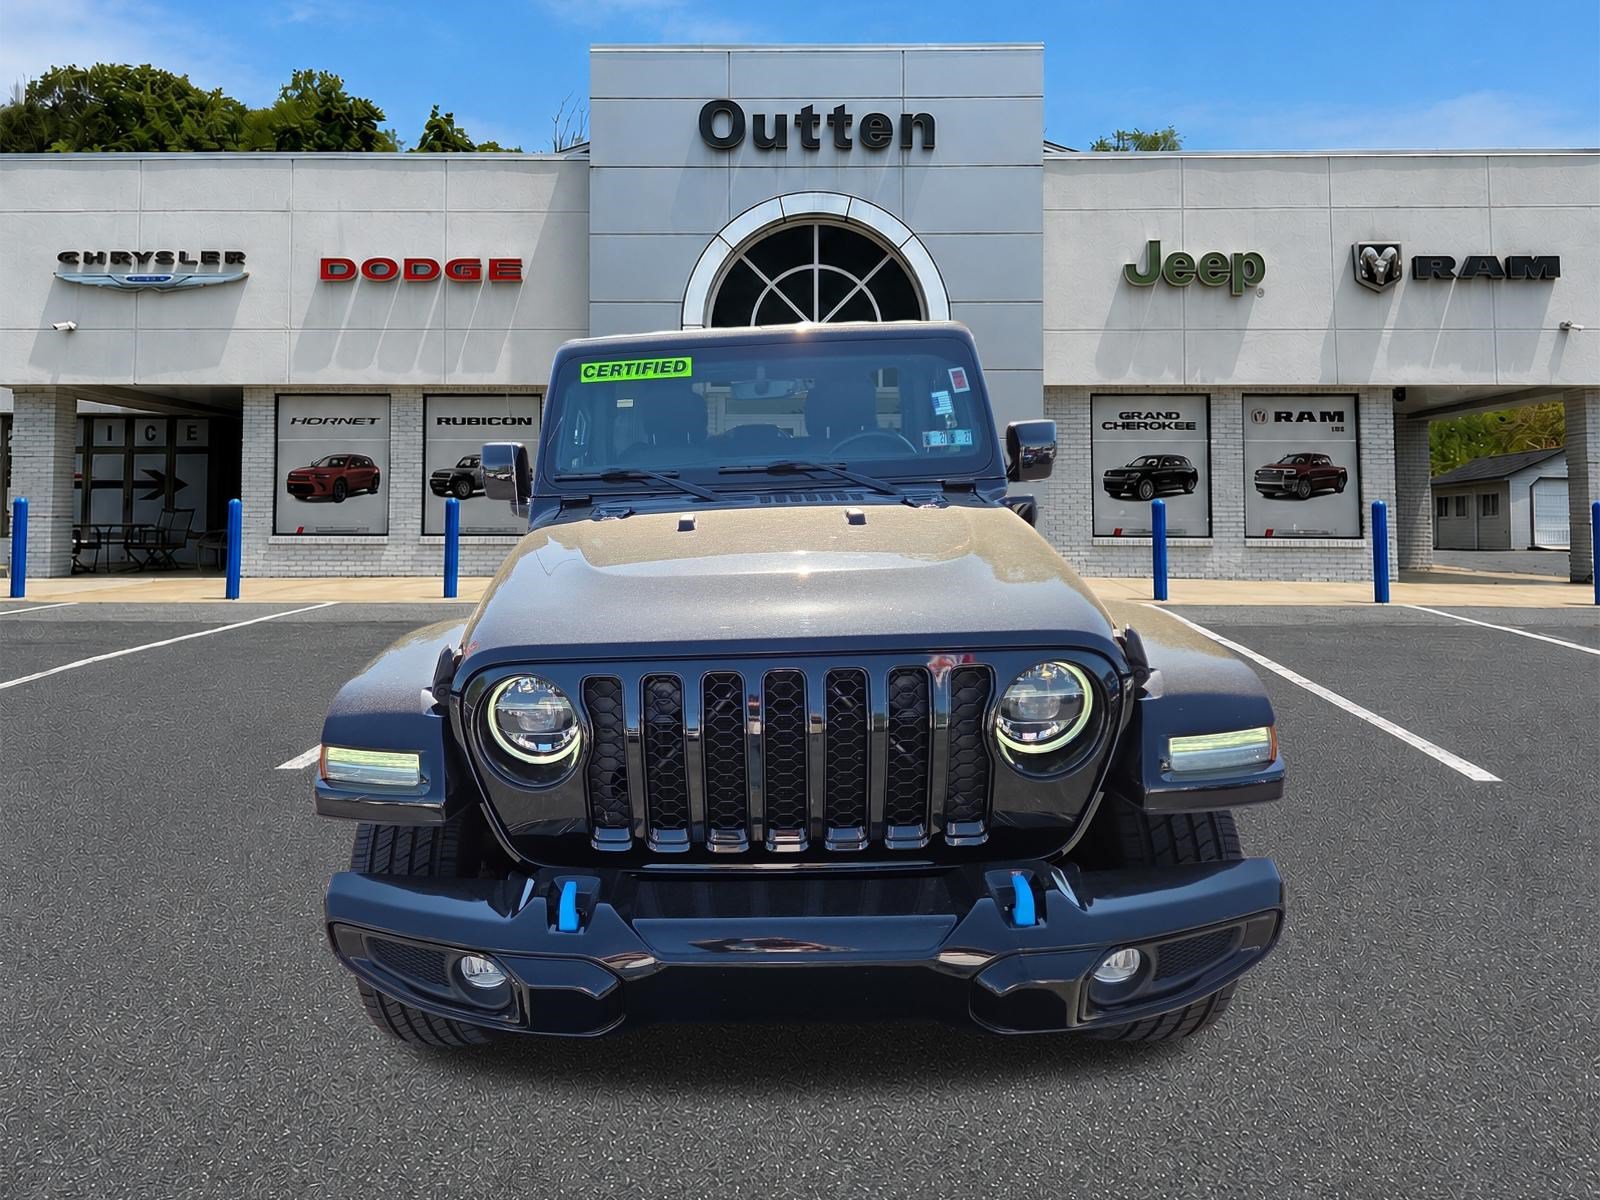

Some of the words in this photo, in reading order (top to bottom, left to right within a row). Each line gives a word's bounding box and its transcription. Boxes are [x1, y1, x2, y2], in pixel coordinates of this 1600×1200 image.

[699, 98, 936, 150] Outten
[57, 251, 246, 266] CHRYSLER
[320, 257, 523, 282] DODGE
[1123, 240, 1266, 297] Jeep
[1411, 255, 1560, 280] RAM
[583, 360, 687, 378] CERTIFIED
[290, 417, 381, 425] HORNET
[436, 417, 533, 426] RUBICON
[1118, 411, 1181, 420] GRAND
[1274, 411, 1345, 423] RAM
[1101, 421, 1197, 431] CHEROKEE
